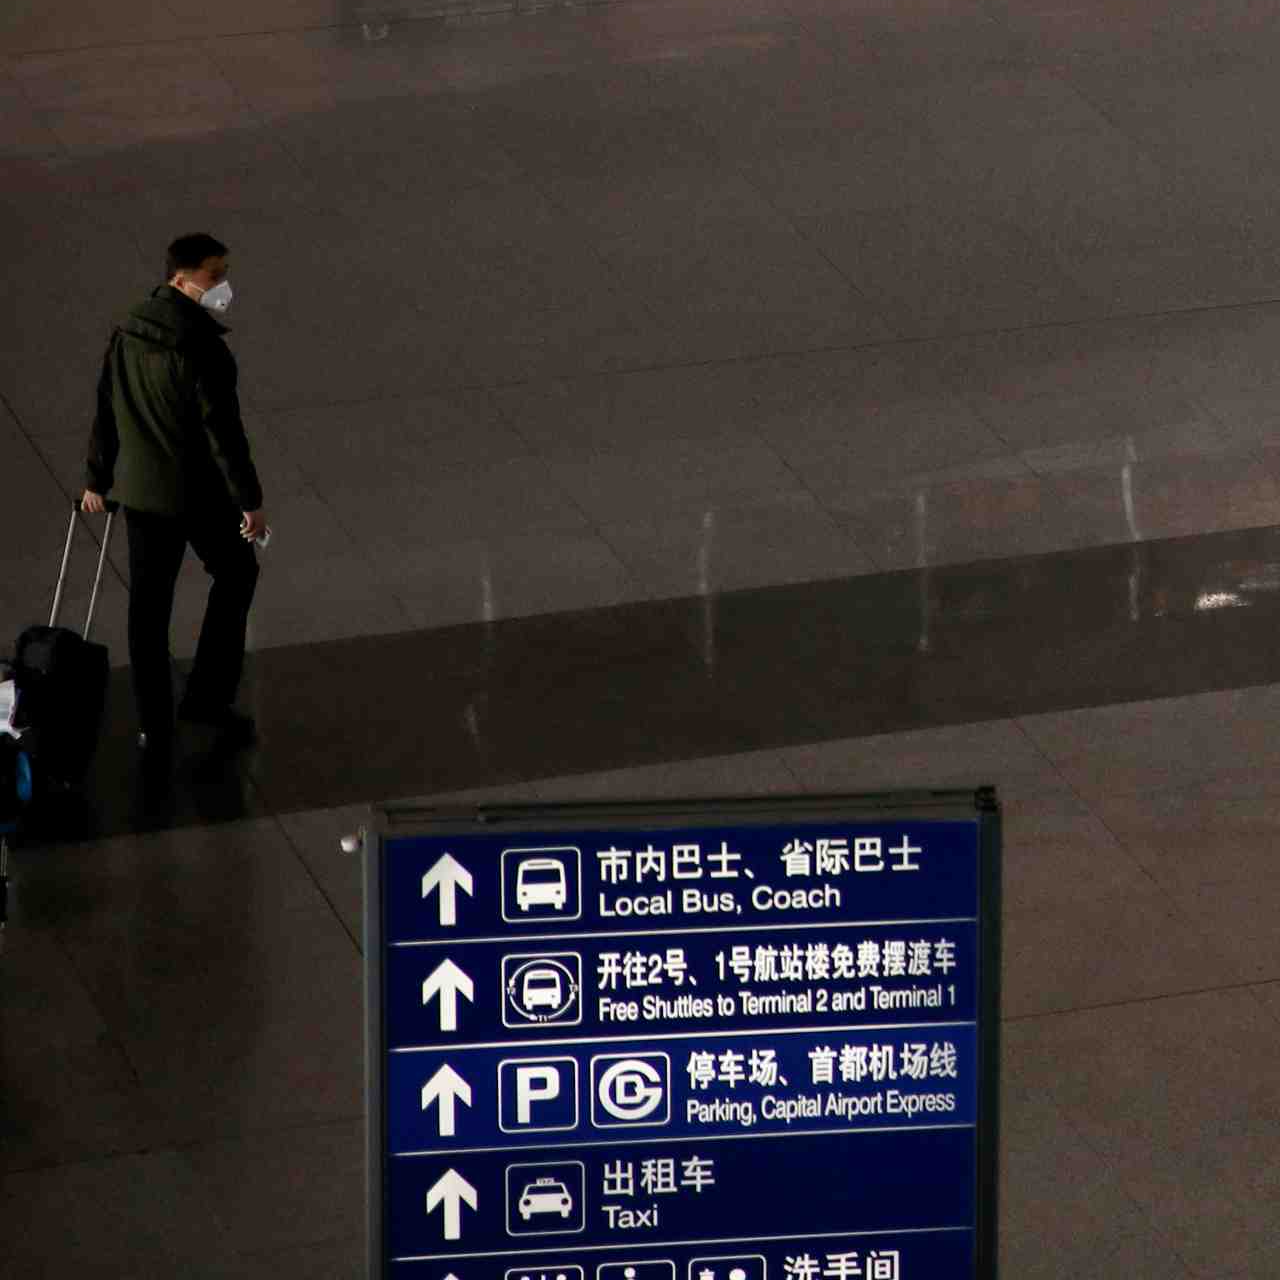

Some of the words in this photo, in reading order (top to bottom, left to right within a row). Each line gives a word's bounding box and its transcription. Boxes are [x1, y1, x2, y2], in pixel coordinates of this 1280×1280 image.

[597, 836, 921, 884] 市内巴士、省际巴士
[600, 890, 672, 916] Local
[683, 889, 741, 914] Bus,
[752, 884, 840, 910] Coach
[599, 998, 638, 1021] Free
[643, 994, 713, 1019] Shuttles
[717, 994, 735, 1016] to
[739, 989, 812, 1015] Terminal
[815, 988, 828, 1012] 2
[832, 987, 865, 1011] and
[871, 984, 942, 1009] Terminal
[946, 984, 956, 1006] 1
[686, 1042, 957, 1089] 停车场、首都机场线
[687, 1098, 756, 1126] Parking,
[761, 1094, 821, 1123] Capital
[825, 1092, 882, 1120] Airport
[887, 1090, 955, 1118] Express
[602, 1156, 716, 1196] 出租车
[601, 1203, 659, 1229] Taxi
[783, 1249, 900, 1280] 洗手间
